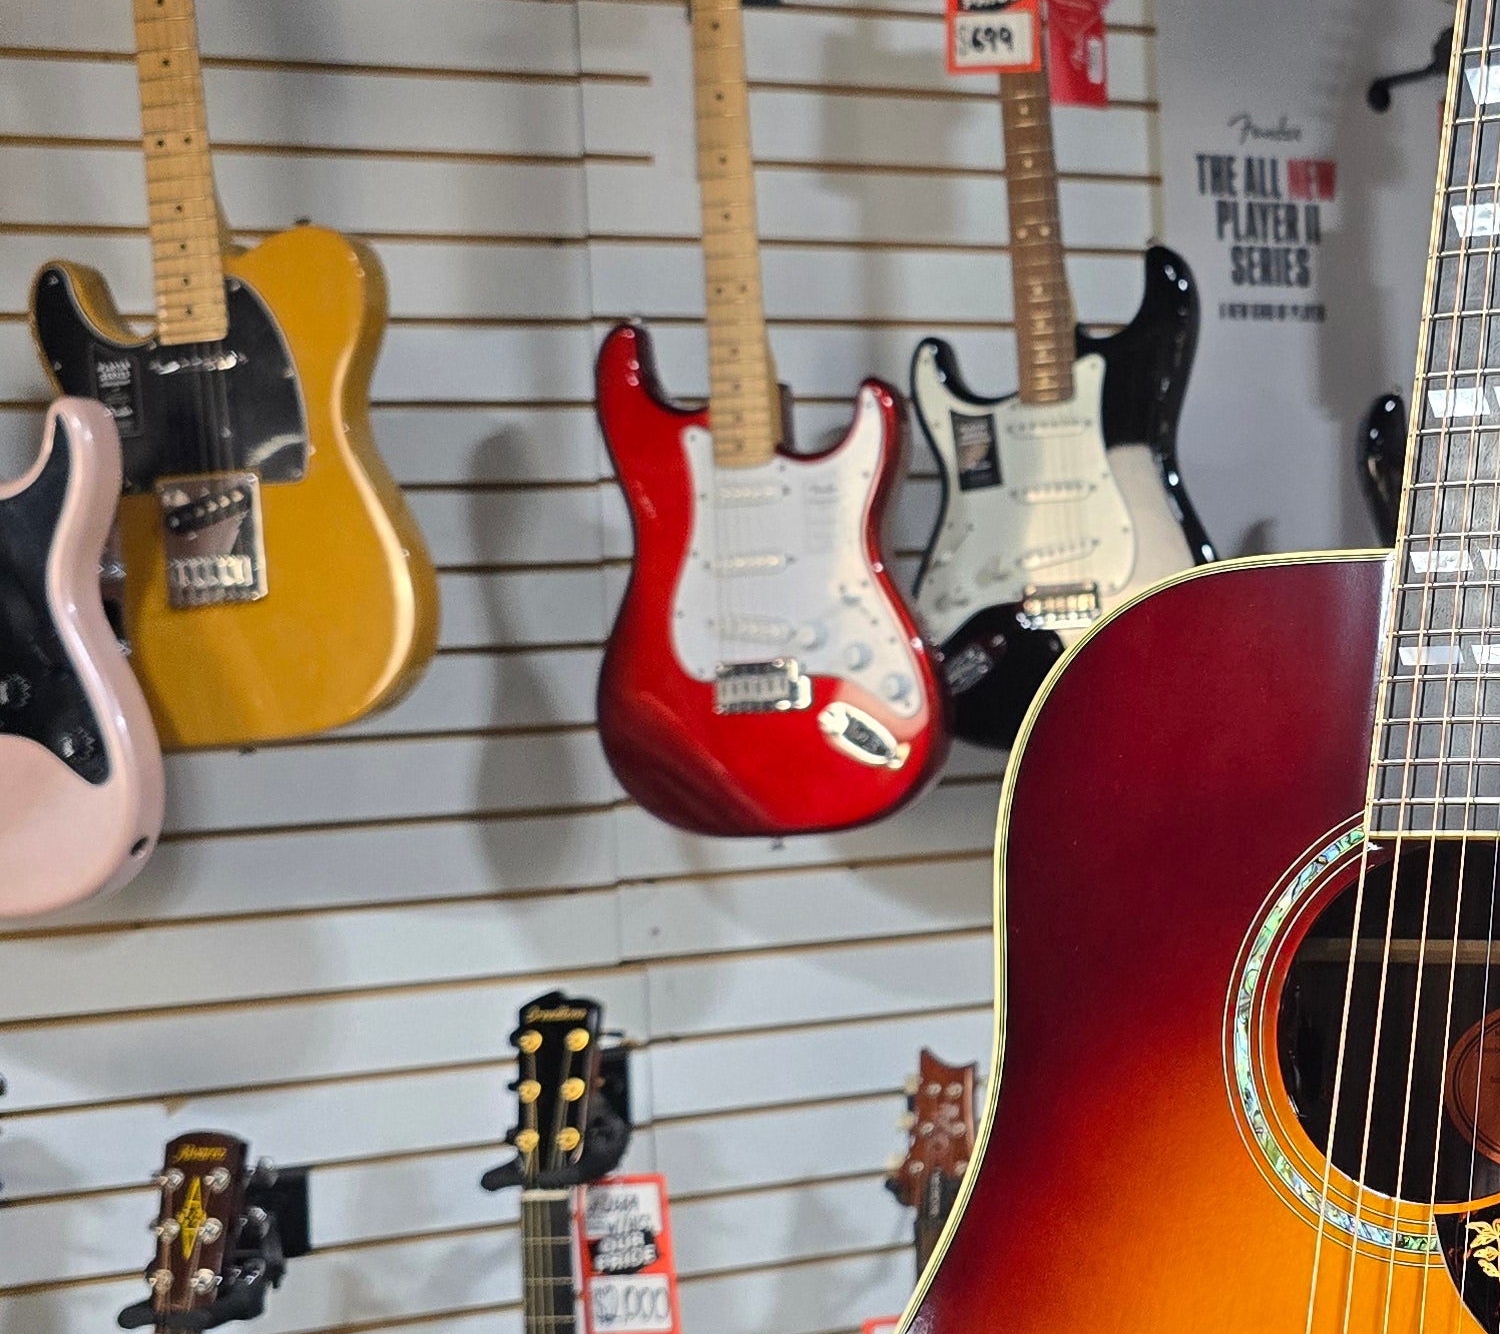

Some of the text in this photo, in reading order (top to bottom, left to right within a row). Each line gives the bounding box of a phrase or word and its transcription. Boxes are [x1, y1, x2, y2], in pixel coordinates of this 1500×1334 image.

[1227, 113, 1302, 145] Fender
[1195, 153, 1237, 196] THE
[1244, 155, 1281, 200] ALL
[1216, 199, 1298, 242] PLAYER
[1231, 245, 1310, 287] SERIES
